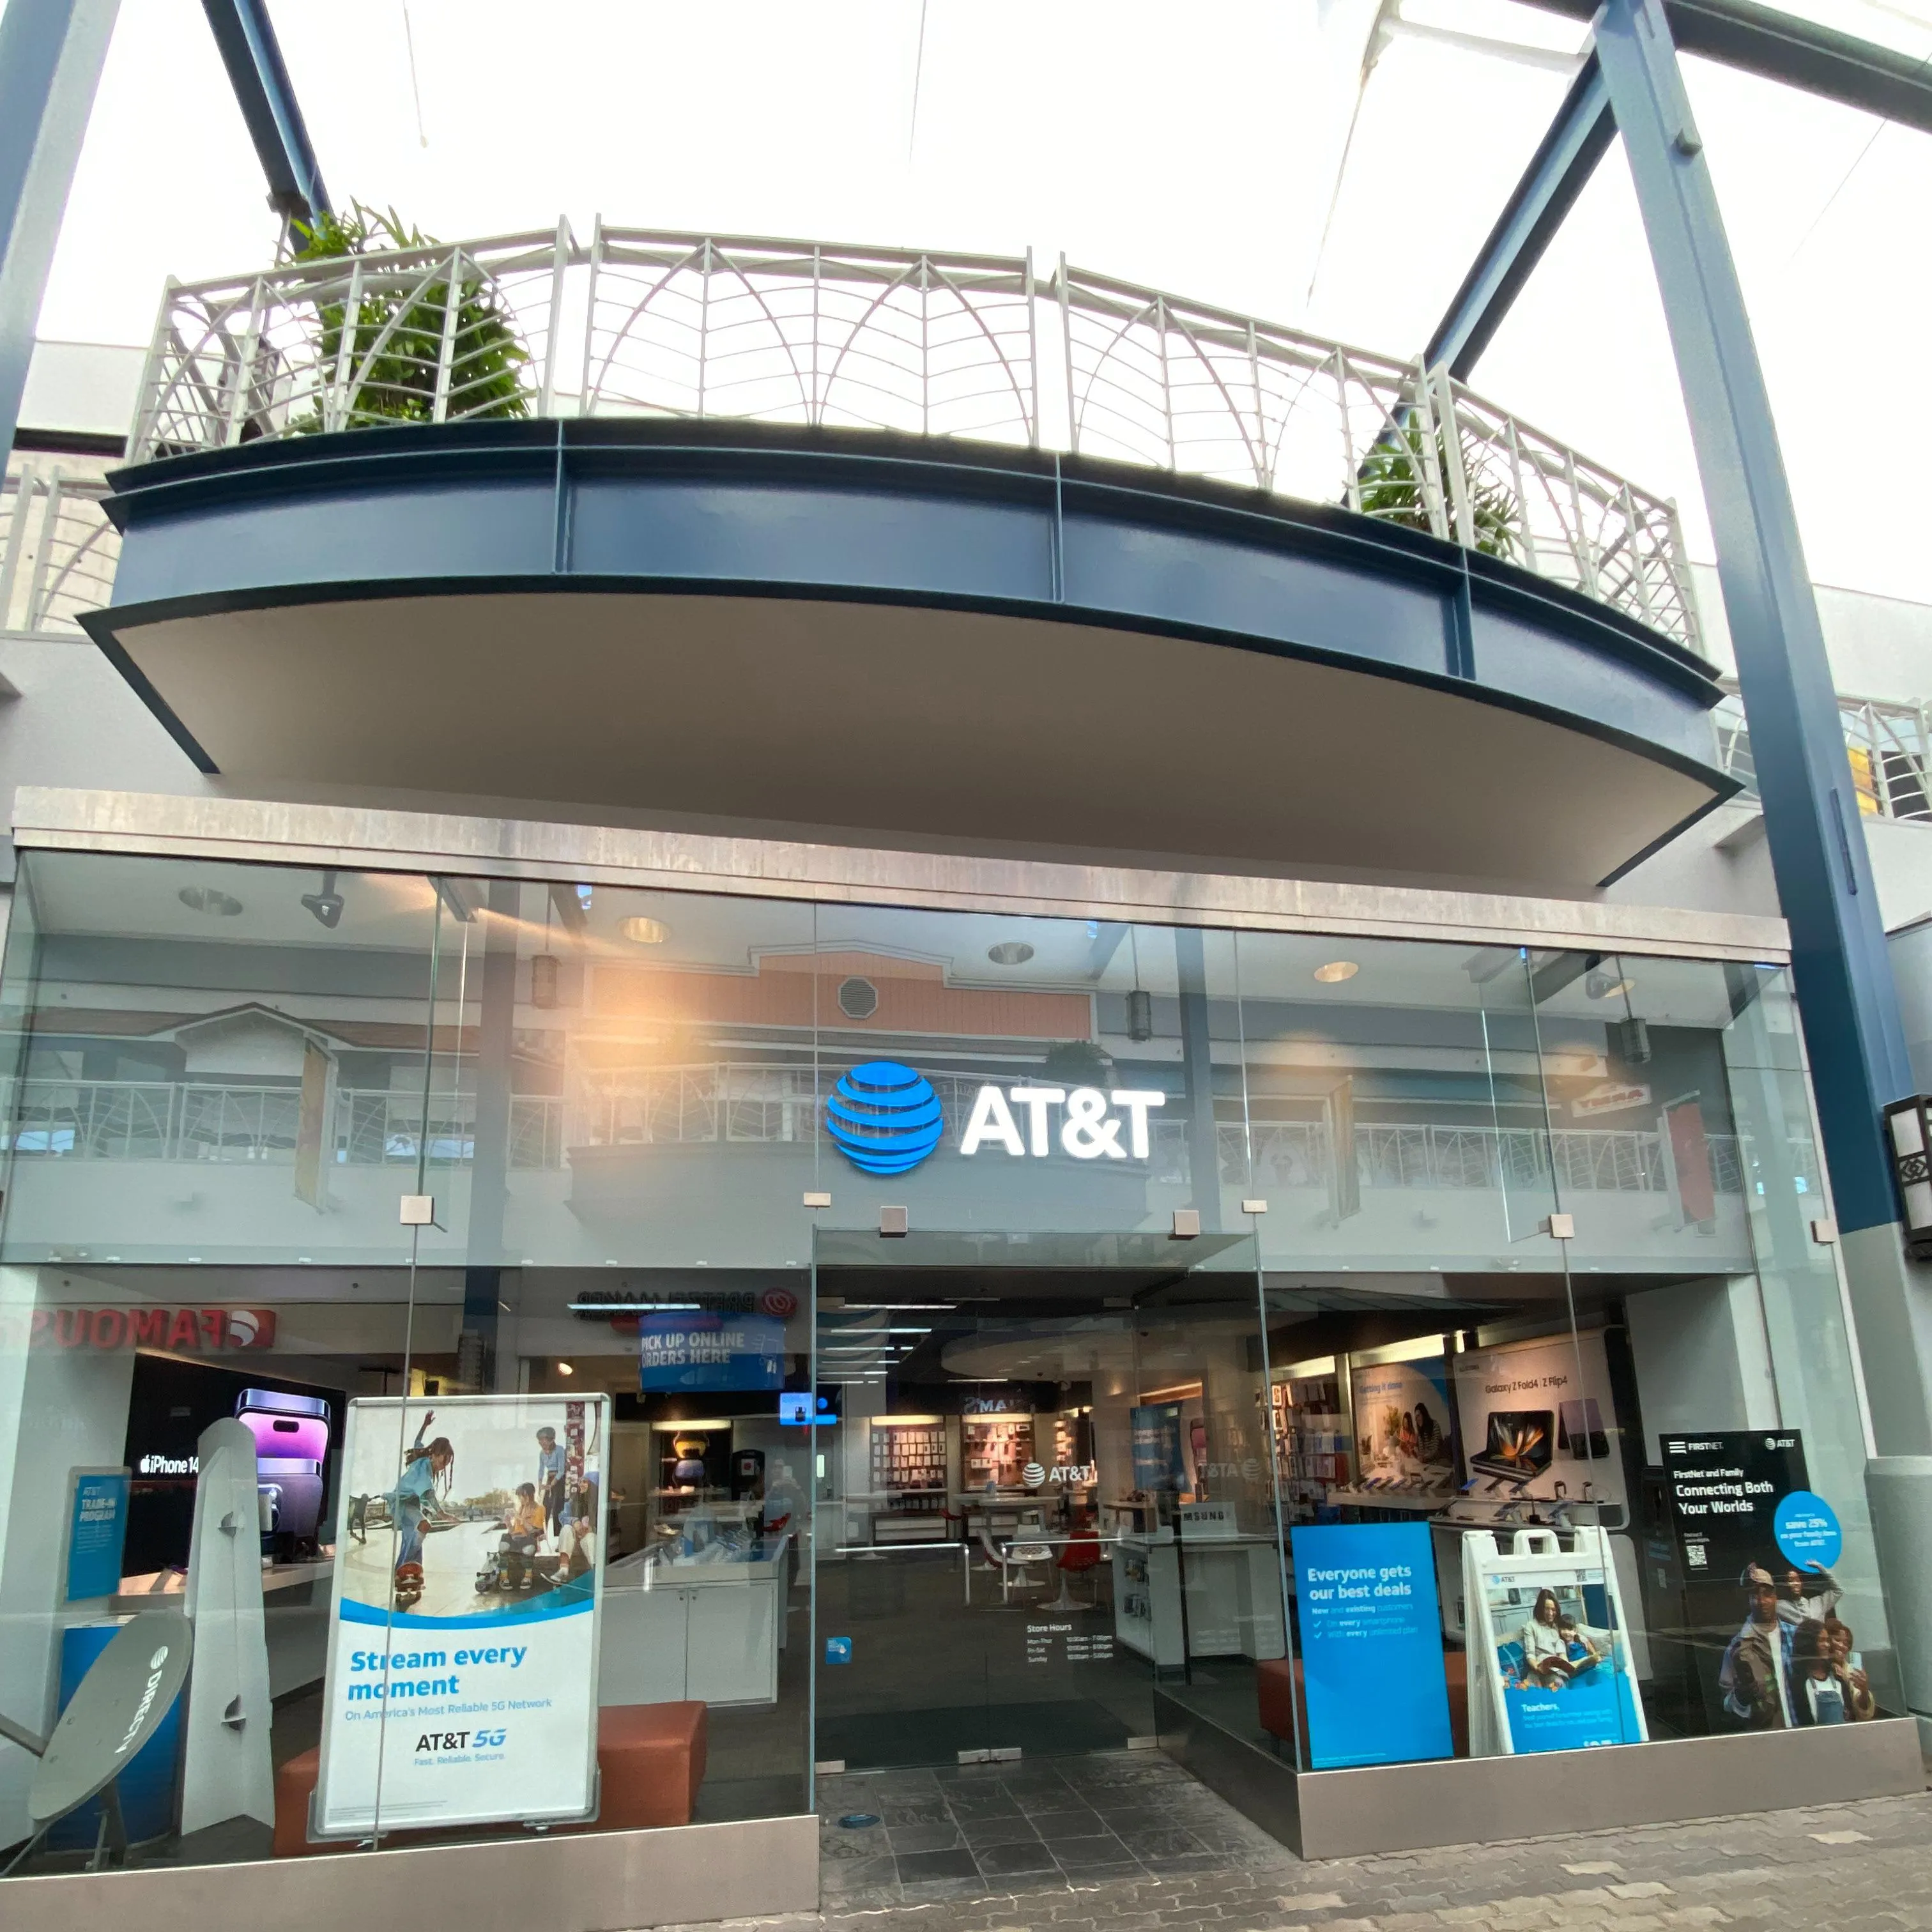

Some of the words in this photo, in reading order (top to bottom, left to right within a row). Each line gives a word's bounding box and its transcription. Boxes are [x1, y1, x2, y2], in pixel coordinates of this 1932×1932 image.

[960, 1085, 1165, 1158] AT&T
[666, 1333, 685, 1348] UP
[689, 1331, 745, 1347] ONLINE
[641, 1349, 686, 1368] ORDERS
[690, 1348, 731, 1364] HERE
[1485, 1383, 1511, 1394] Galaxy
[1512, 1381, 1517, 1391] Z
[1518, 1379, 1538, 1389] Fold4
[1542, 1377, 1547, 1387] Z
[1549, 1376, 1568, 1388] Flip4
[1777, 1439, 1795, 1448] AT&T
[150, 1455, 188, 1473] iPhone
[189, 1456, 199, 1473] 14
[1048, 1466, 1091, 1483] AT&T
[1674, 1469, 1704, 1479] FirstNet
[1706, 1469, 1720, 1478] and
[1721, 1468, 1744, 1478] Family
[1676, 1483, 1744, 1497] Connecting
[1745, 1481, 1774, 1494] Both
[1678, 1502, 1708, 1515] Your
[1710, 1500, 1754, 1514] Worlds
[1307, 1567, 1376, 1584] Everyone
[1380, 1565, 1411, 1581] gets
[1309, 1588, 1335, 1600] our
[1338, 1584, 1370, 1599] best
[1374, 1581, 1411, 1597] deals
[1346, 1604, 1376, 1614] existing
[1027, 1625, 1048, 1634] Store
[1049, 1623, 1072, 1632] Hours
[1339, 1619, 1361, 1628] every
[1346, 1629, 1368, 1639] every
[350, 1650, 446, 1671] Stream
[454, 1646, 528, 1668] every
[348, 1675, 459, 1701] moment
[114, 1669, 162, 1754] DIRECTV
[345, 1710, 361, 1721] On
[364, 1707, 415, 1720] America's
[418, 1705, 445, 1716] Most
[448, 1703, 489, 1714] Reliable
[491, 1701, 505, 1712] 5G
[508, 1698, 552, 1709] Network
[415, 1731, 470, 1752] AT&T
[472, 1728, 507, 1749] 5G
[414, 1757, 434, 1767] Fast.
[437, 1755, 472, 1765] Reliable.
